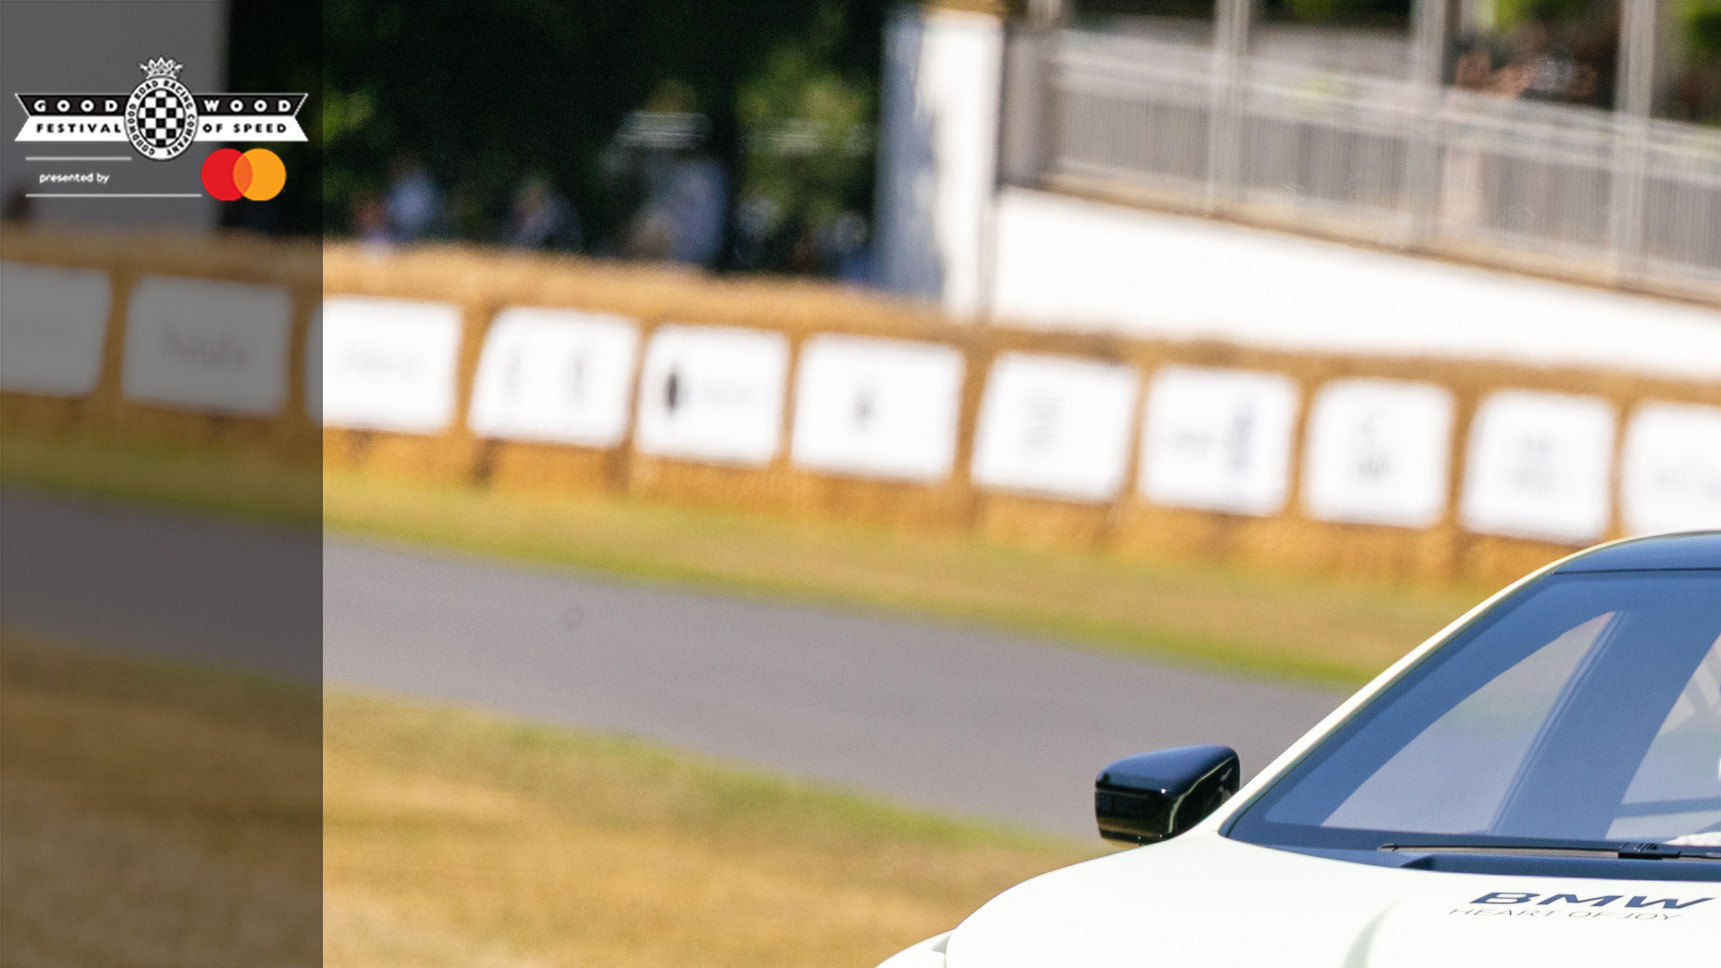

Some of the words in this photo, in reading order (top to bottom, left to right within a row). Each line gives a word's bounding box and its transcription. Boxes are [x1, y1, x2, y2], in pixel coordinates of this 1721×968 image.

[1469, 891, 1716, 910] BMW
[1448, 907, 1563, 918] HEART
[1568, 909, 1617, 919] OF
[1616, 912, 1682, 921] JOY
